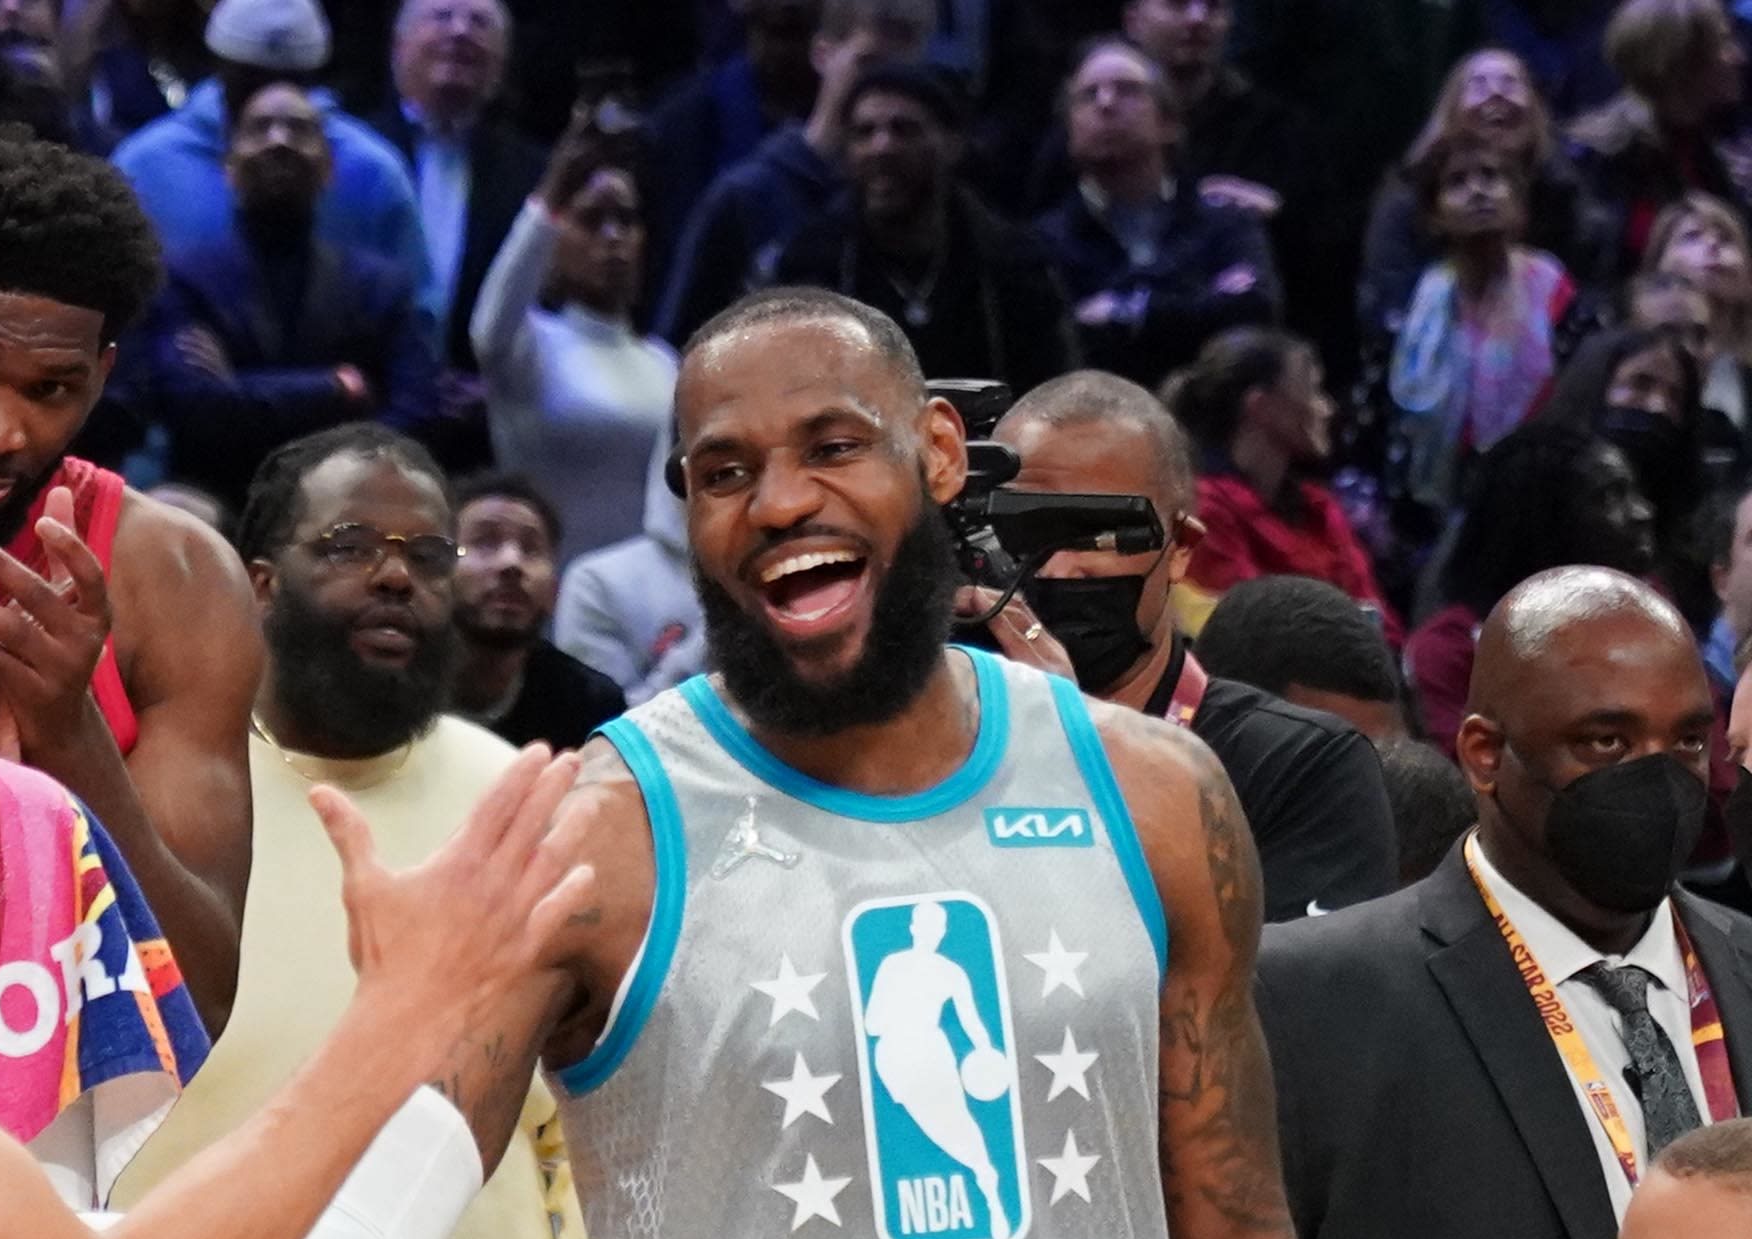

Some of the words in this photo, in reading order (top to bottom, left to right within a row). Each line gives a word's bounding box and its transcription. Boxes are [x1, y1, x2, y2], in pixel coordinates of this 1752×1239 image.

[993, 813, 1084, 838] KIA
[1533, 990, 1574, 1036] 2022
[898, 1174, 974, 1235] NBA
